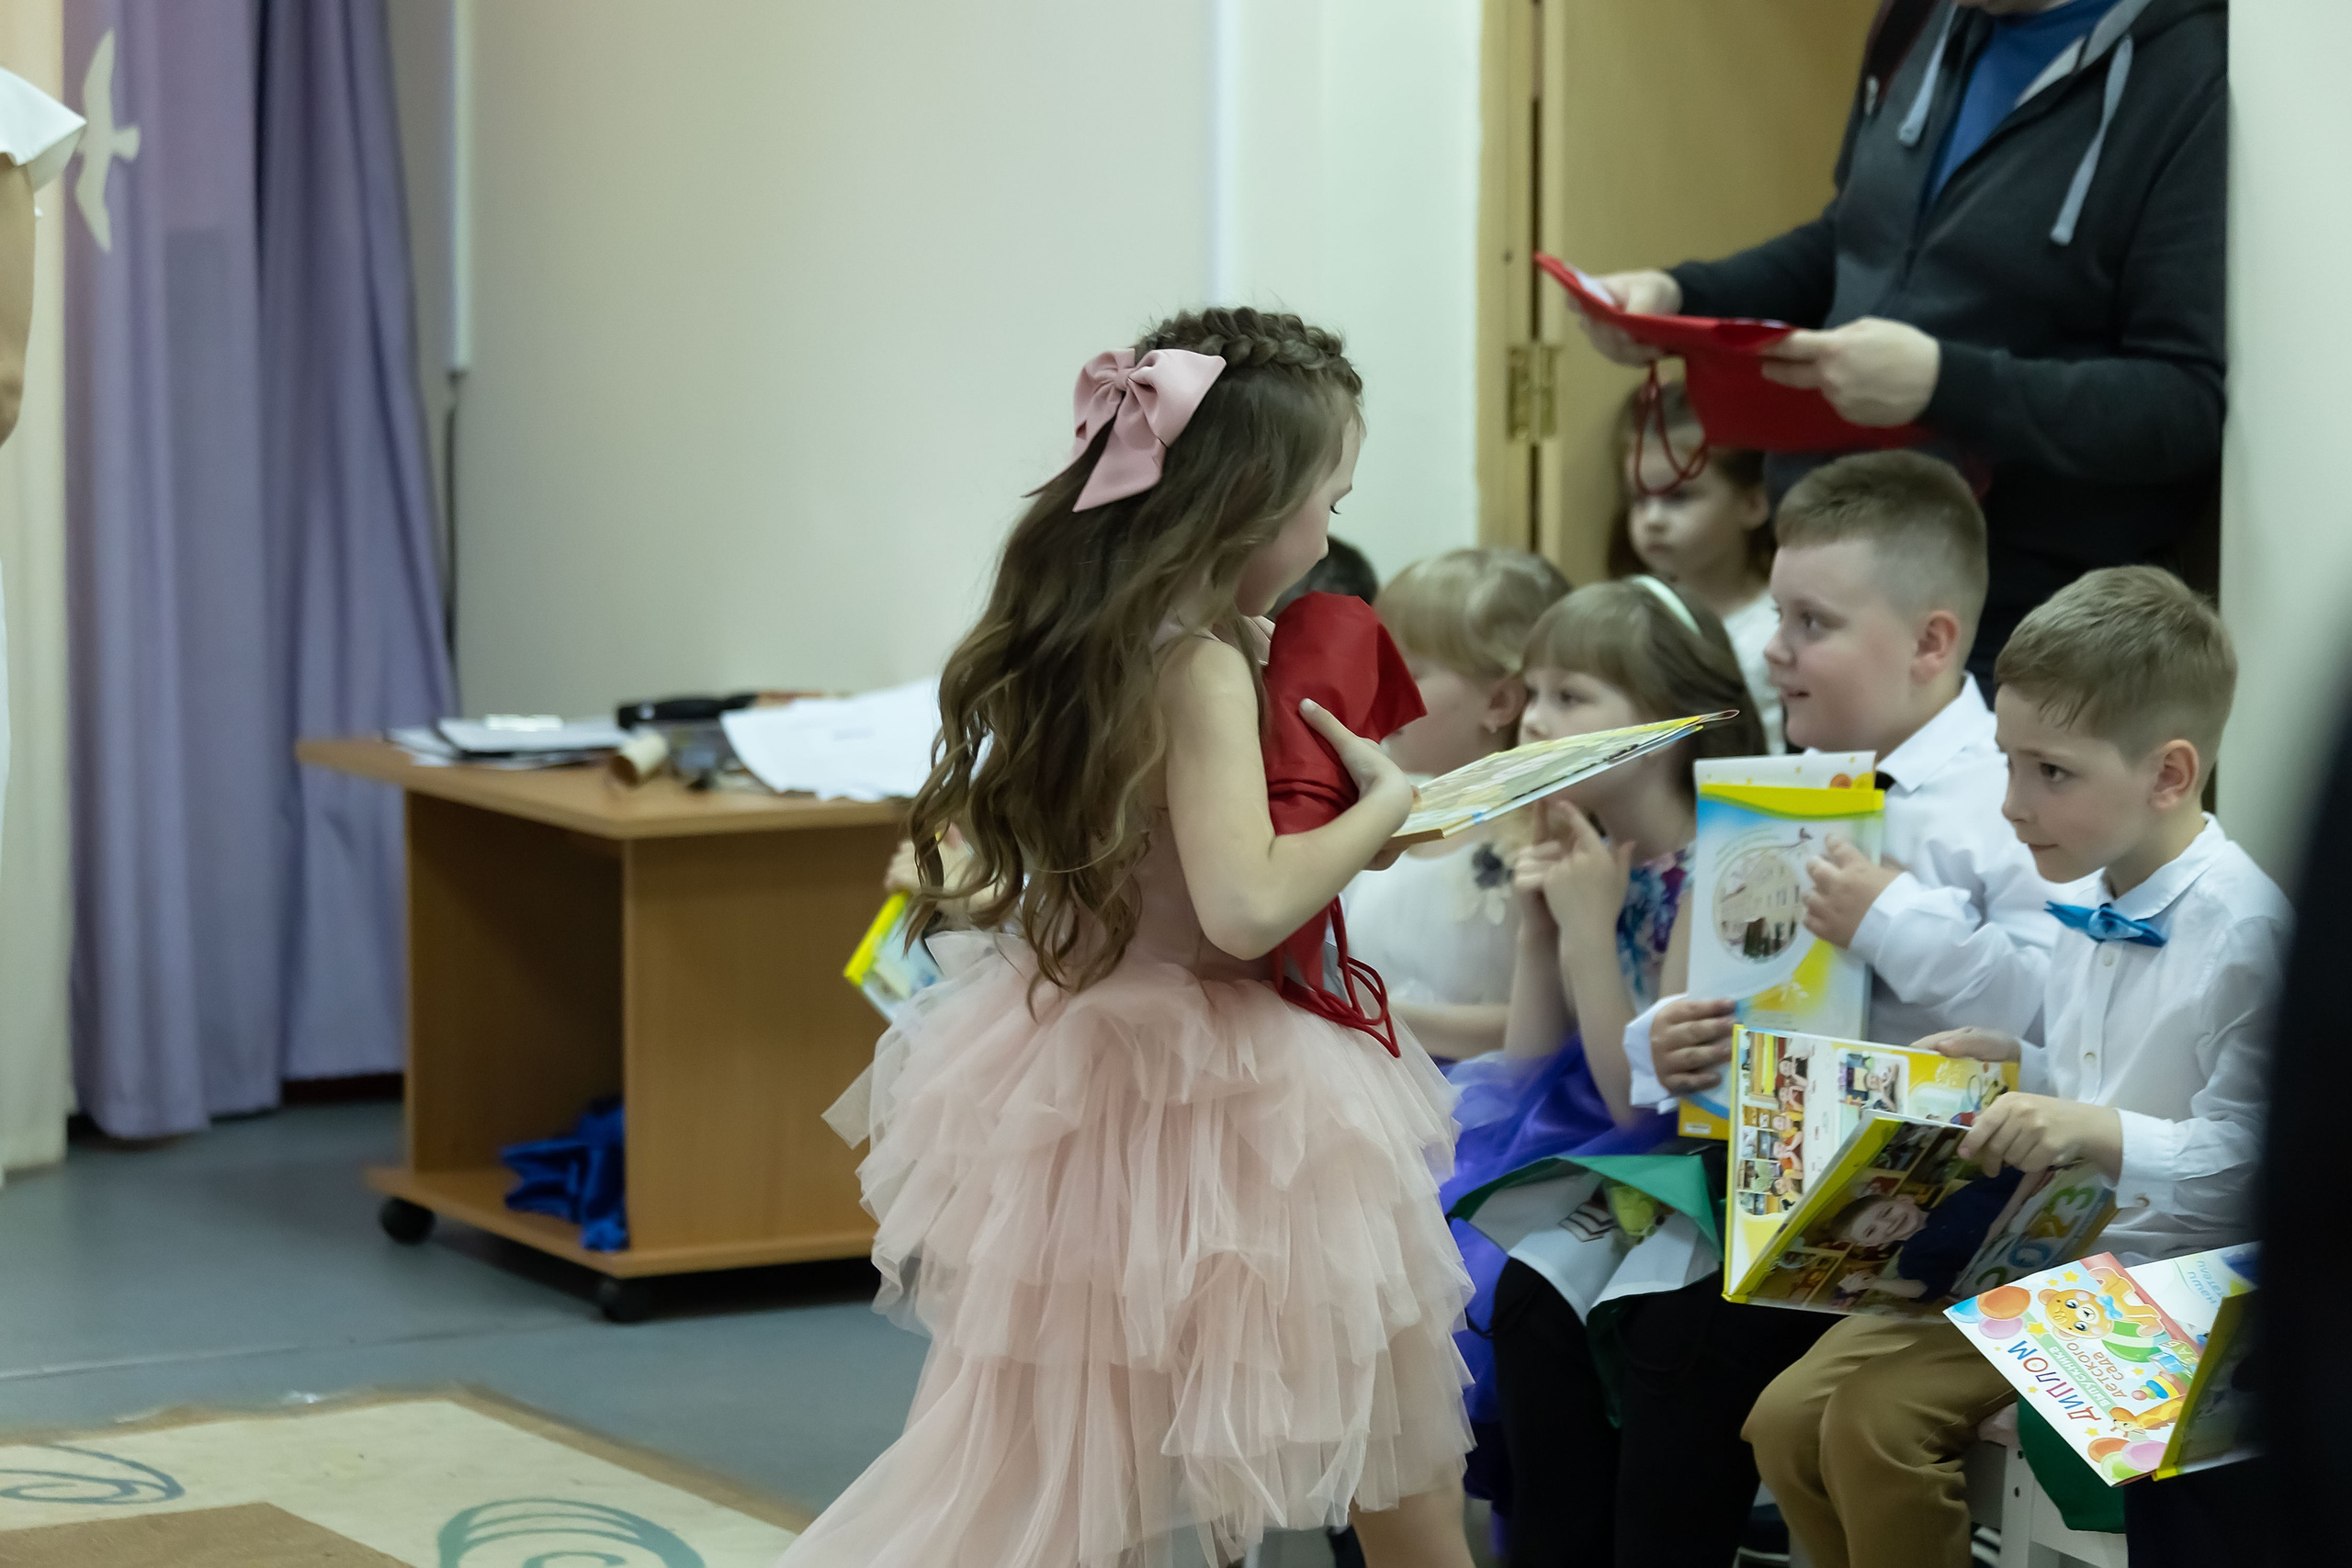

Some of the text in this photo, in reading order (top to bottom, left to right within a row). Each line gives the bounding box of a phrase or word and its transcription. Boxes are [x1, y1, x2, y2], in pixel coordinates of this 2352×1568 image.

[2197, 1260, 2225, 1298] татели
[2007, 1340, 2102, 1423] ДИПЛОМ
[2049, 1346, 2110, 1408] выпускника
[2067, 1342, 2128, 1398] детского
[2093, 1351, 2125, 1381] сада
